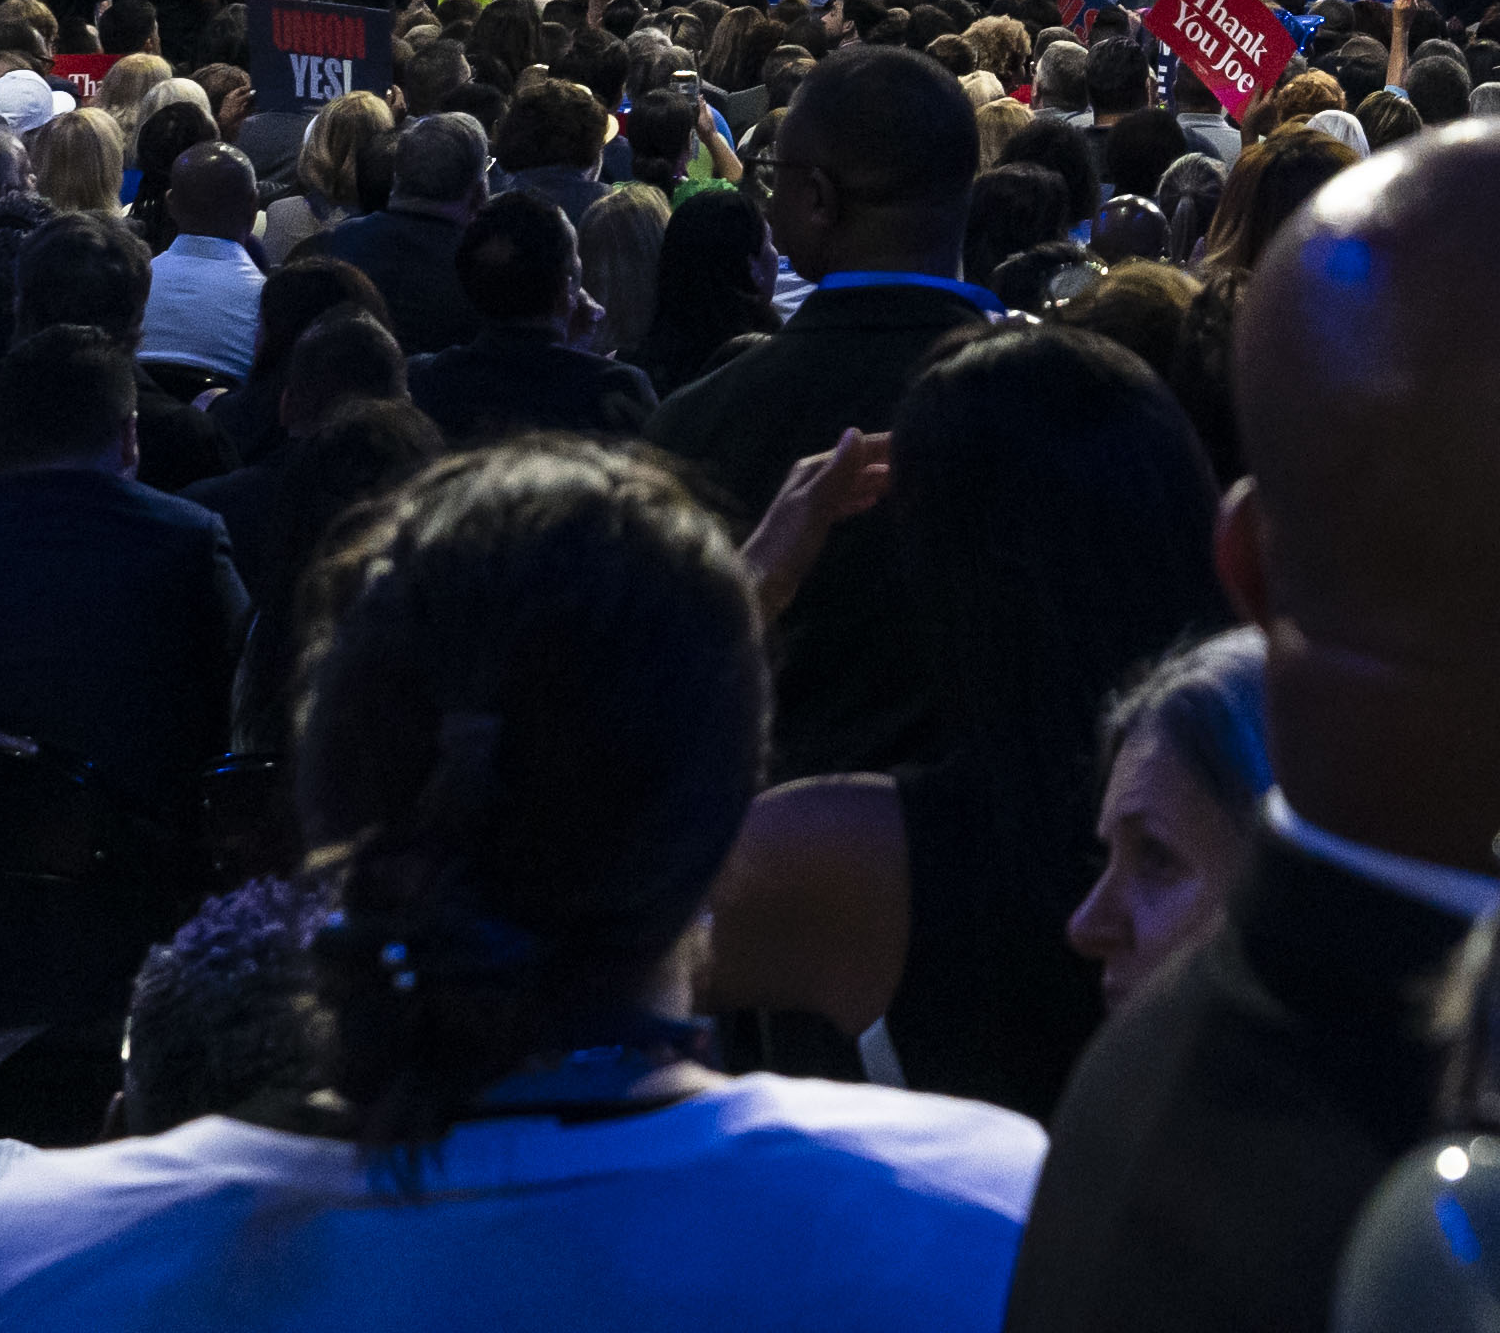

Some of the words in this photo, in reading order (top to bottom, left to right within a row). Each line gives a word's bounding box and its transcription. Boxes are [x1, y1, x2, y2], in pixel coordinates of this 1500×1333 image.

[271, 8, 366, 61] UNION
[1172, 0, 1221, 59] You
[1214, 51, 1256, 94] Joe
[289, 53, 353, 100] YES!
